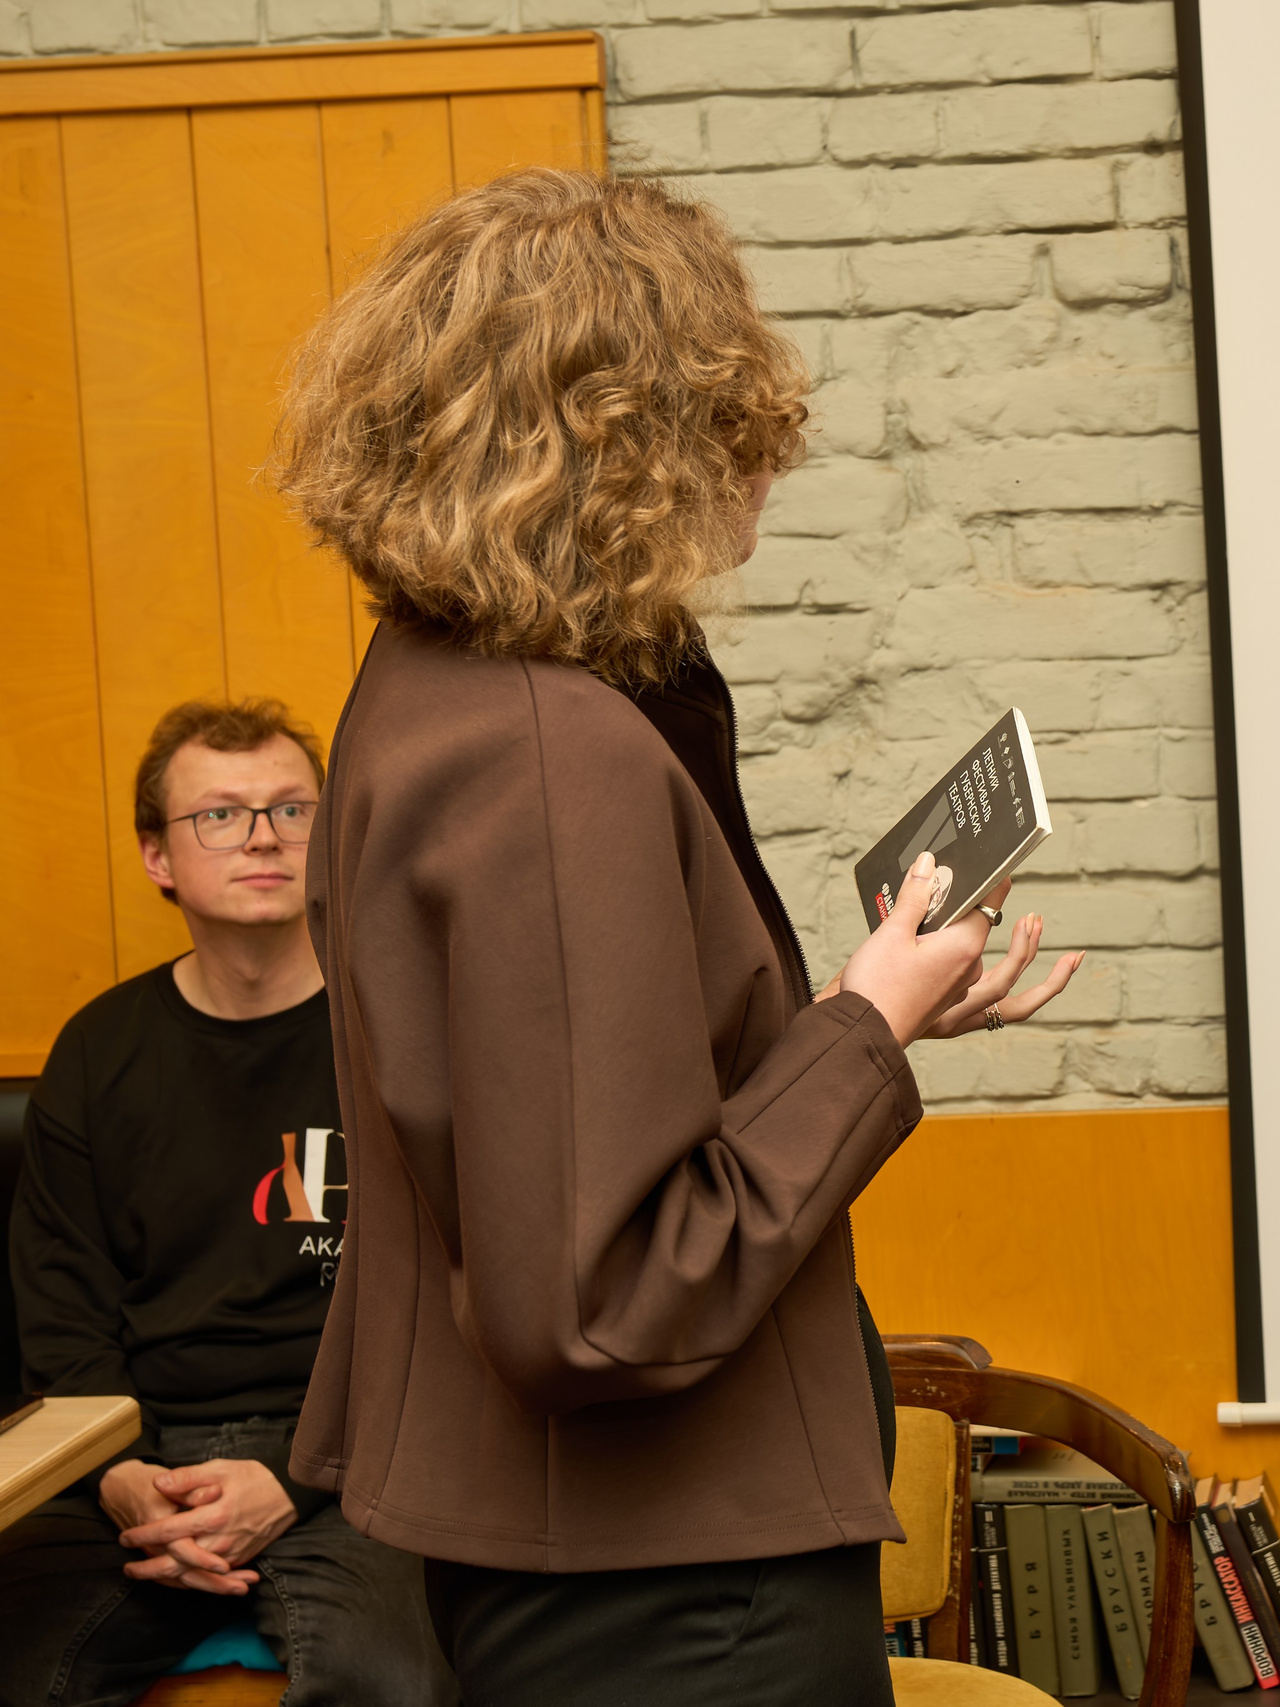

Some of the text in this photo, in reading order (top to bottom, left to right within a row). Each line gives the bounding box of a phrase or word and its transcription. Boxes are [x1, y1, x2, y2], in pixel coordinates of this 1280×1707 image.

[959, 769, 982, 838] ГУБЕРНСКИХ
[972, 759, 993, 823] ФЕСТИВАЛЬ
[982, 747, 1000, 792] ЛЕТНИЙ
[948, 780, 967, 829] ТЕАТРОВ
[1024, 1561, 1042, 1640] БУРЯ
[1061, 1528, 1081, 1660] СЕМЬЯ УЛЬЯНОВЫХ
[1096, 1530, 1129, 1633] БРУСКИ
[1213, 1555, 1255, 1625] ИНКАССАТОР
[1242, 1625, 1275, 1678] ВОРОНИН
